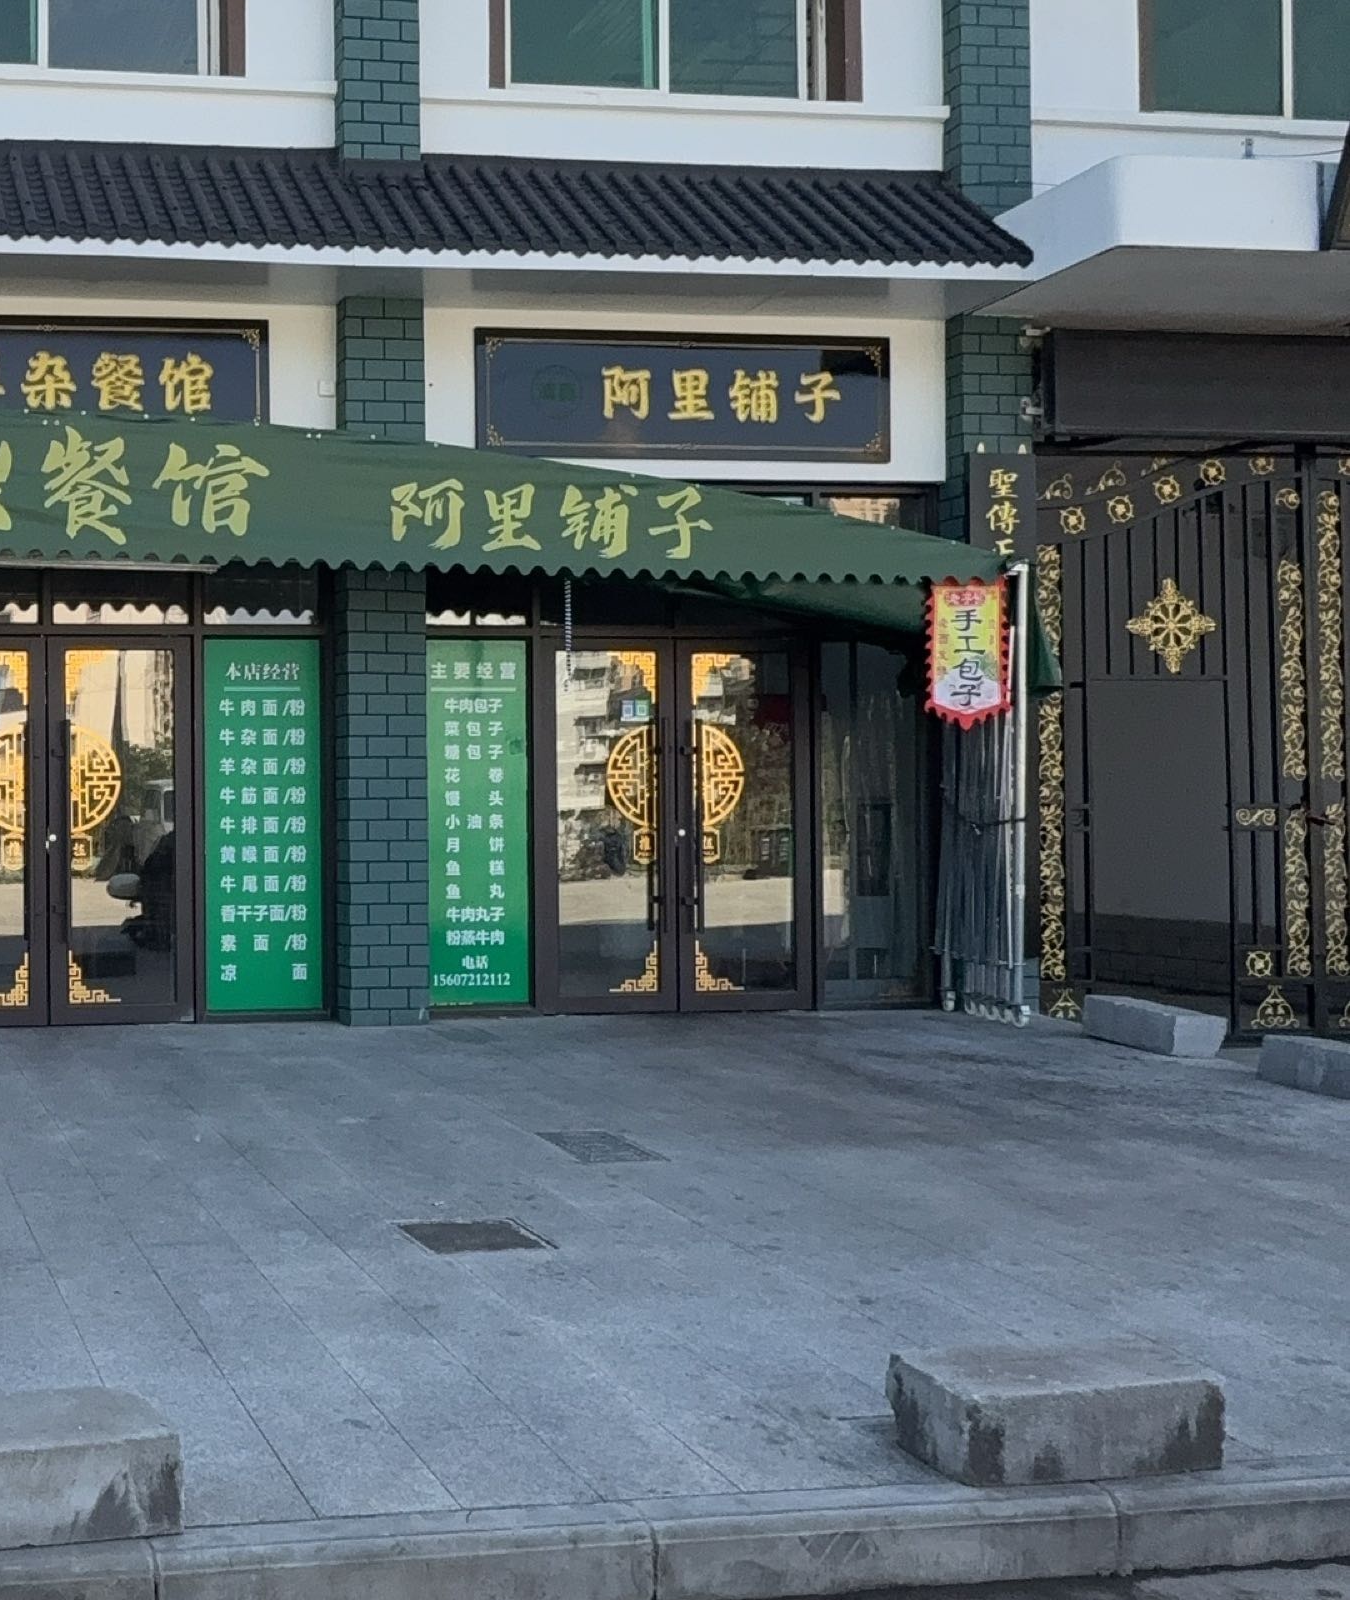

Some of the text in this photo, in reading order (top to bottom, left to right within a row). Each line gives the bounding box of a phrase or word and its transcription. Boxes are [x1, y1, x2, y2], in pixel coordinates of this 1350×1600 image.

[602, 367, 840, 422] 阿里铺子
[390, 478, 713, 559] 阿里铺子
[950, 608, 986, 706] 手工包子
[226, 663, 299, 680] 本店经营
[431, 662, 515, 679] 主要经营
[463, 956, 488, 969] 电话
[434, 974, 510, 986] 15607212112
